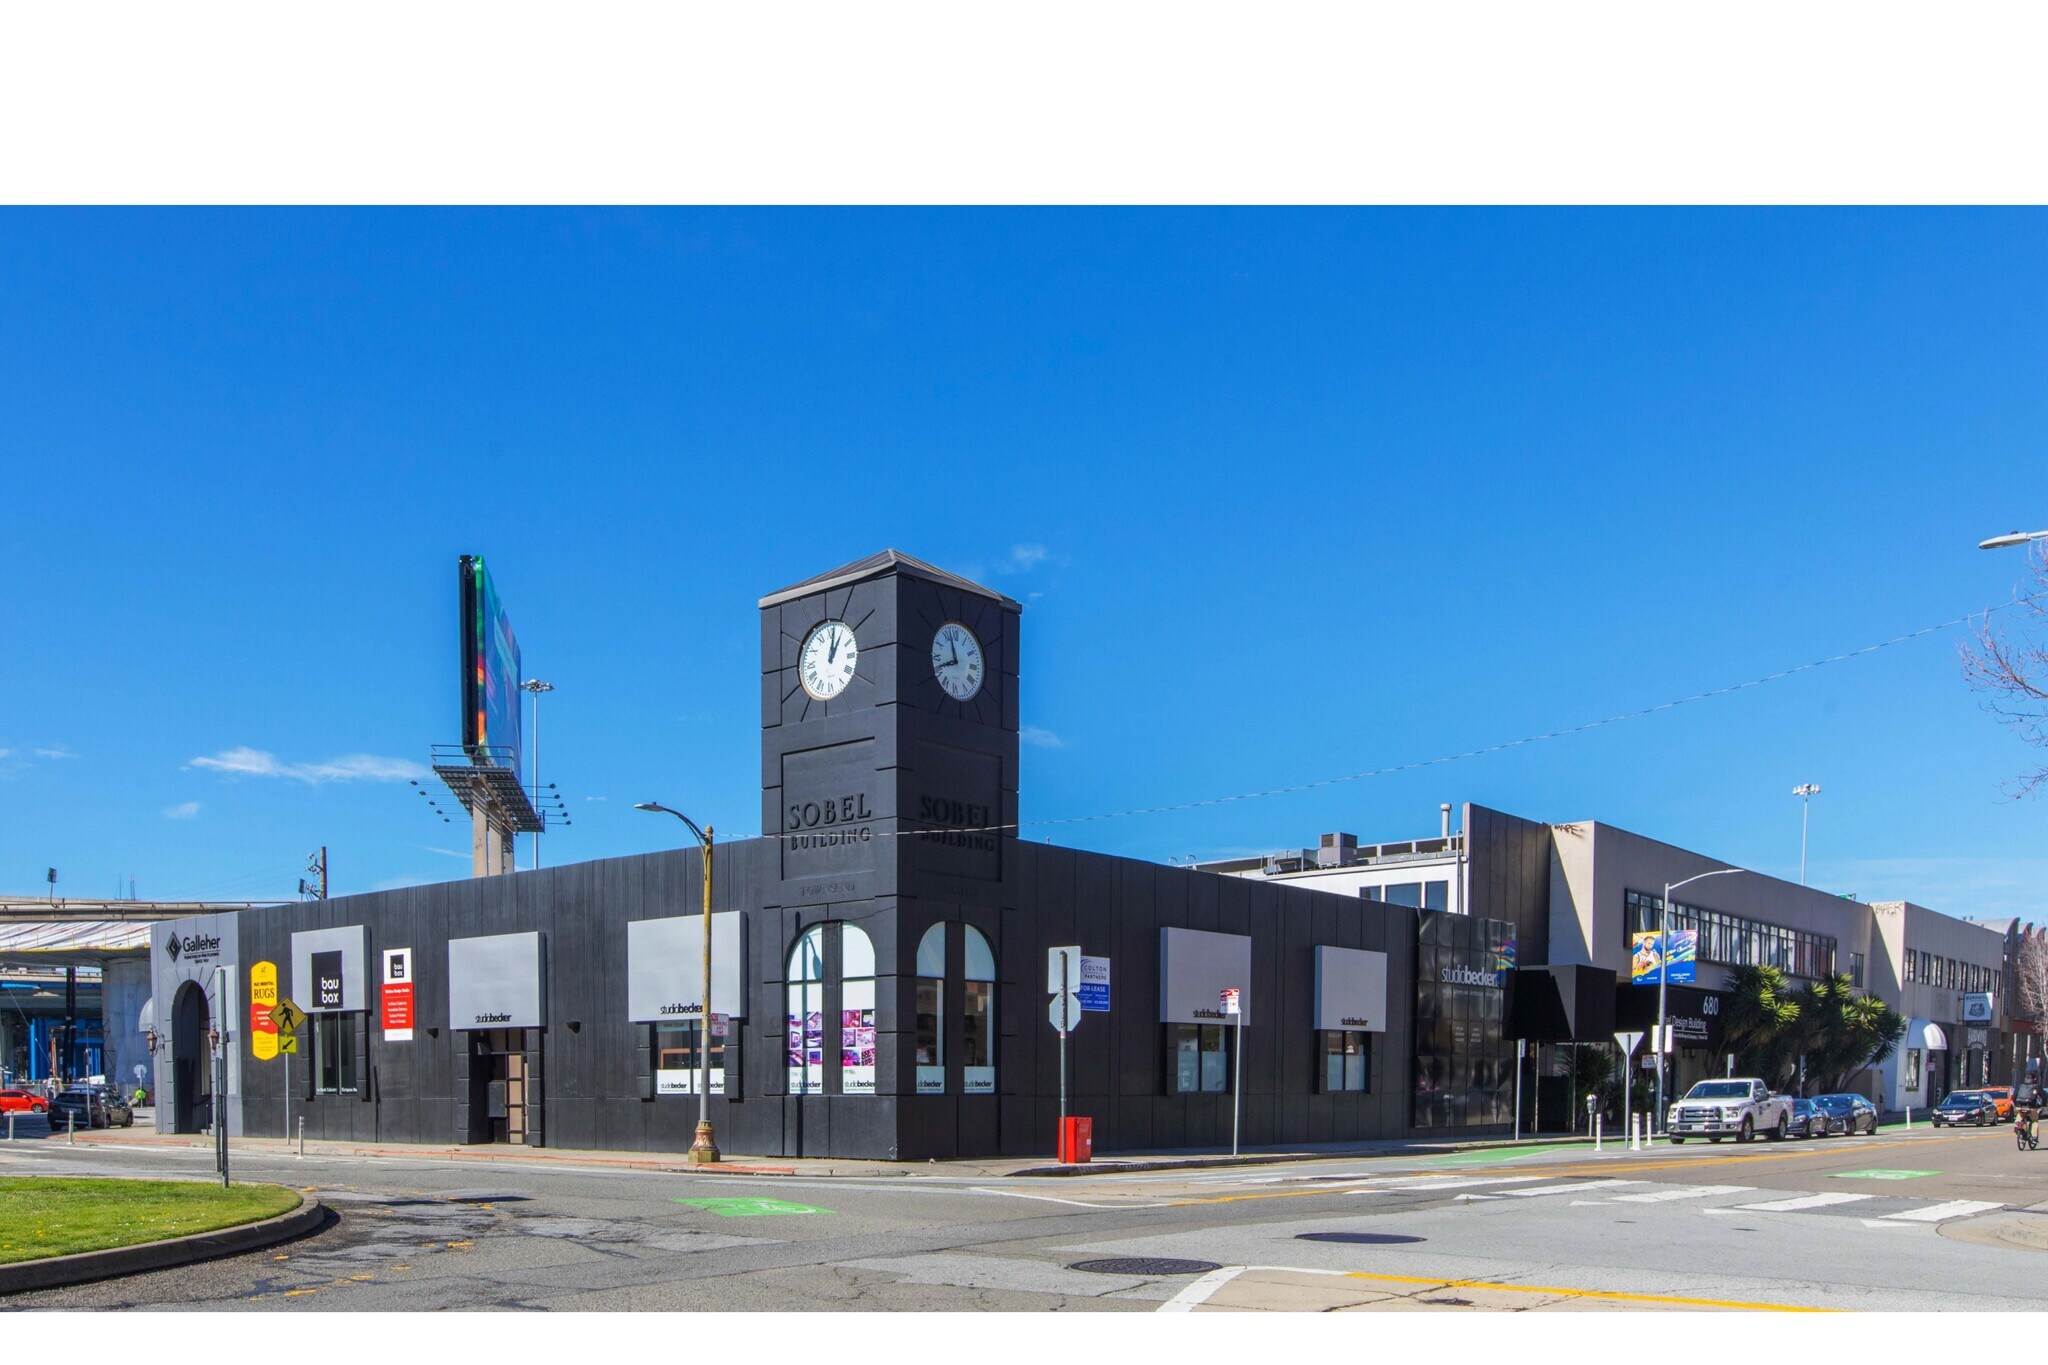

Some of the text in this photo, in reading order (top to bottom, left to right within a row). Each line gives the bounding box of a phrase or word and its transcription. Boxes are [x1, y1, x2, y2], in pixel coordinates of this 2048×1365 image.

[789, 793, 872, 830] SOBEL
[920, 795, 990, 828] SOBEL
[791, 827, 871, 851] BUILDING
[182, 933, 221, 952] Galleher
[321, 976, 339, 990] bau
[1441, 964, 1499, 988] studiobecker
[253, 988, 276, 1000] RUGS
[321, 990, 339, 1004] box
[1703, 995, 1719, 1016] 680
[1688, 1016, 1707, 1033] Building
